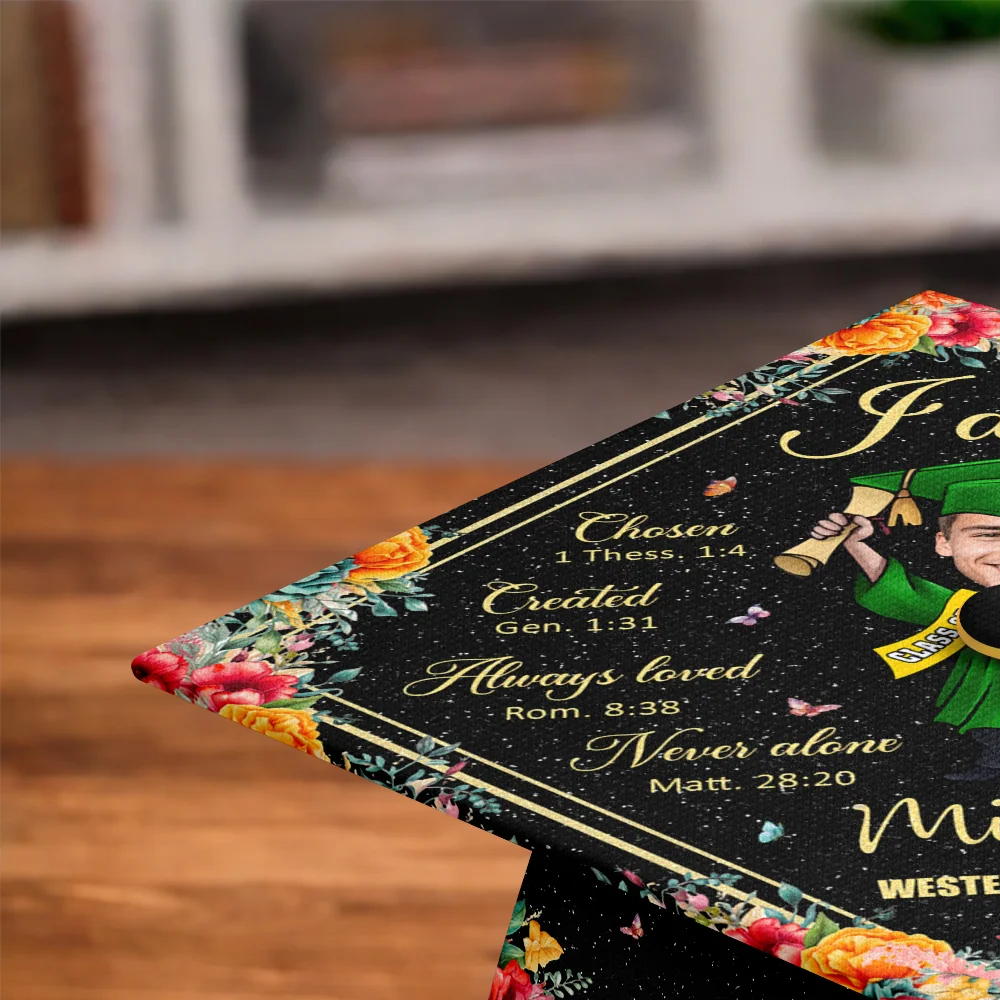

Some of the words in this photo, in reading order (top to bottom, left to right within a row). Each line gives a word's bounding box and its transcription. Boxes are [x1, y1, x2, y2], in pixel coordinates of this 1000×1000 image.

[780, 374, 976, 460] I
[574, 511, 739, 543] Chosen
[555, 550, 571, 563] 1
[583, 547, 684, 562] Thess.
[699, 544, 747, 558] 1:4
[482, 581, 662, 615] Created
[495, 621, 572, 635] Gen.
[586, 616, 658, 632] 1:31
[886, 626, 960, 663] CLASS
[403, 656, 624, 701] Always
[636, 653, 764, 684] loved
[505, 705, 590, 721] Rom.
[604, 700, 680, 717] 8:38
[570, 728, 757, 772] Never
[769, 727, 903, 757] alone
[650, 776, 741, 793] Matt.
[756, 770, 856, 789] 28:20
